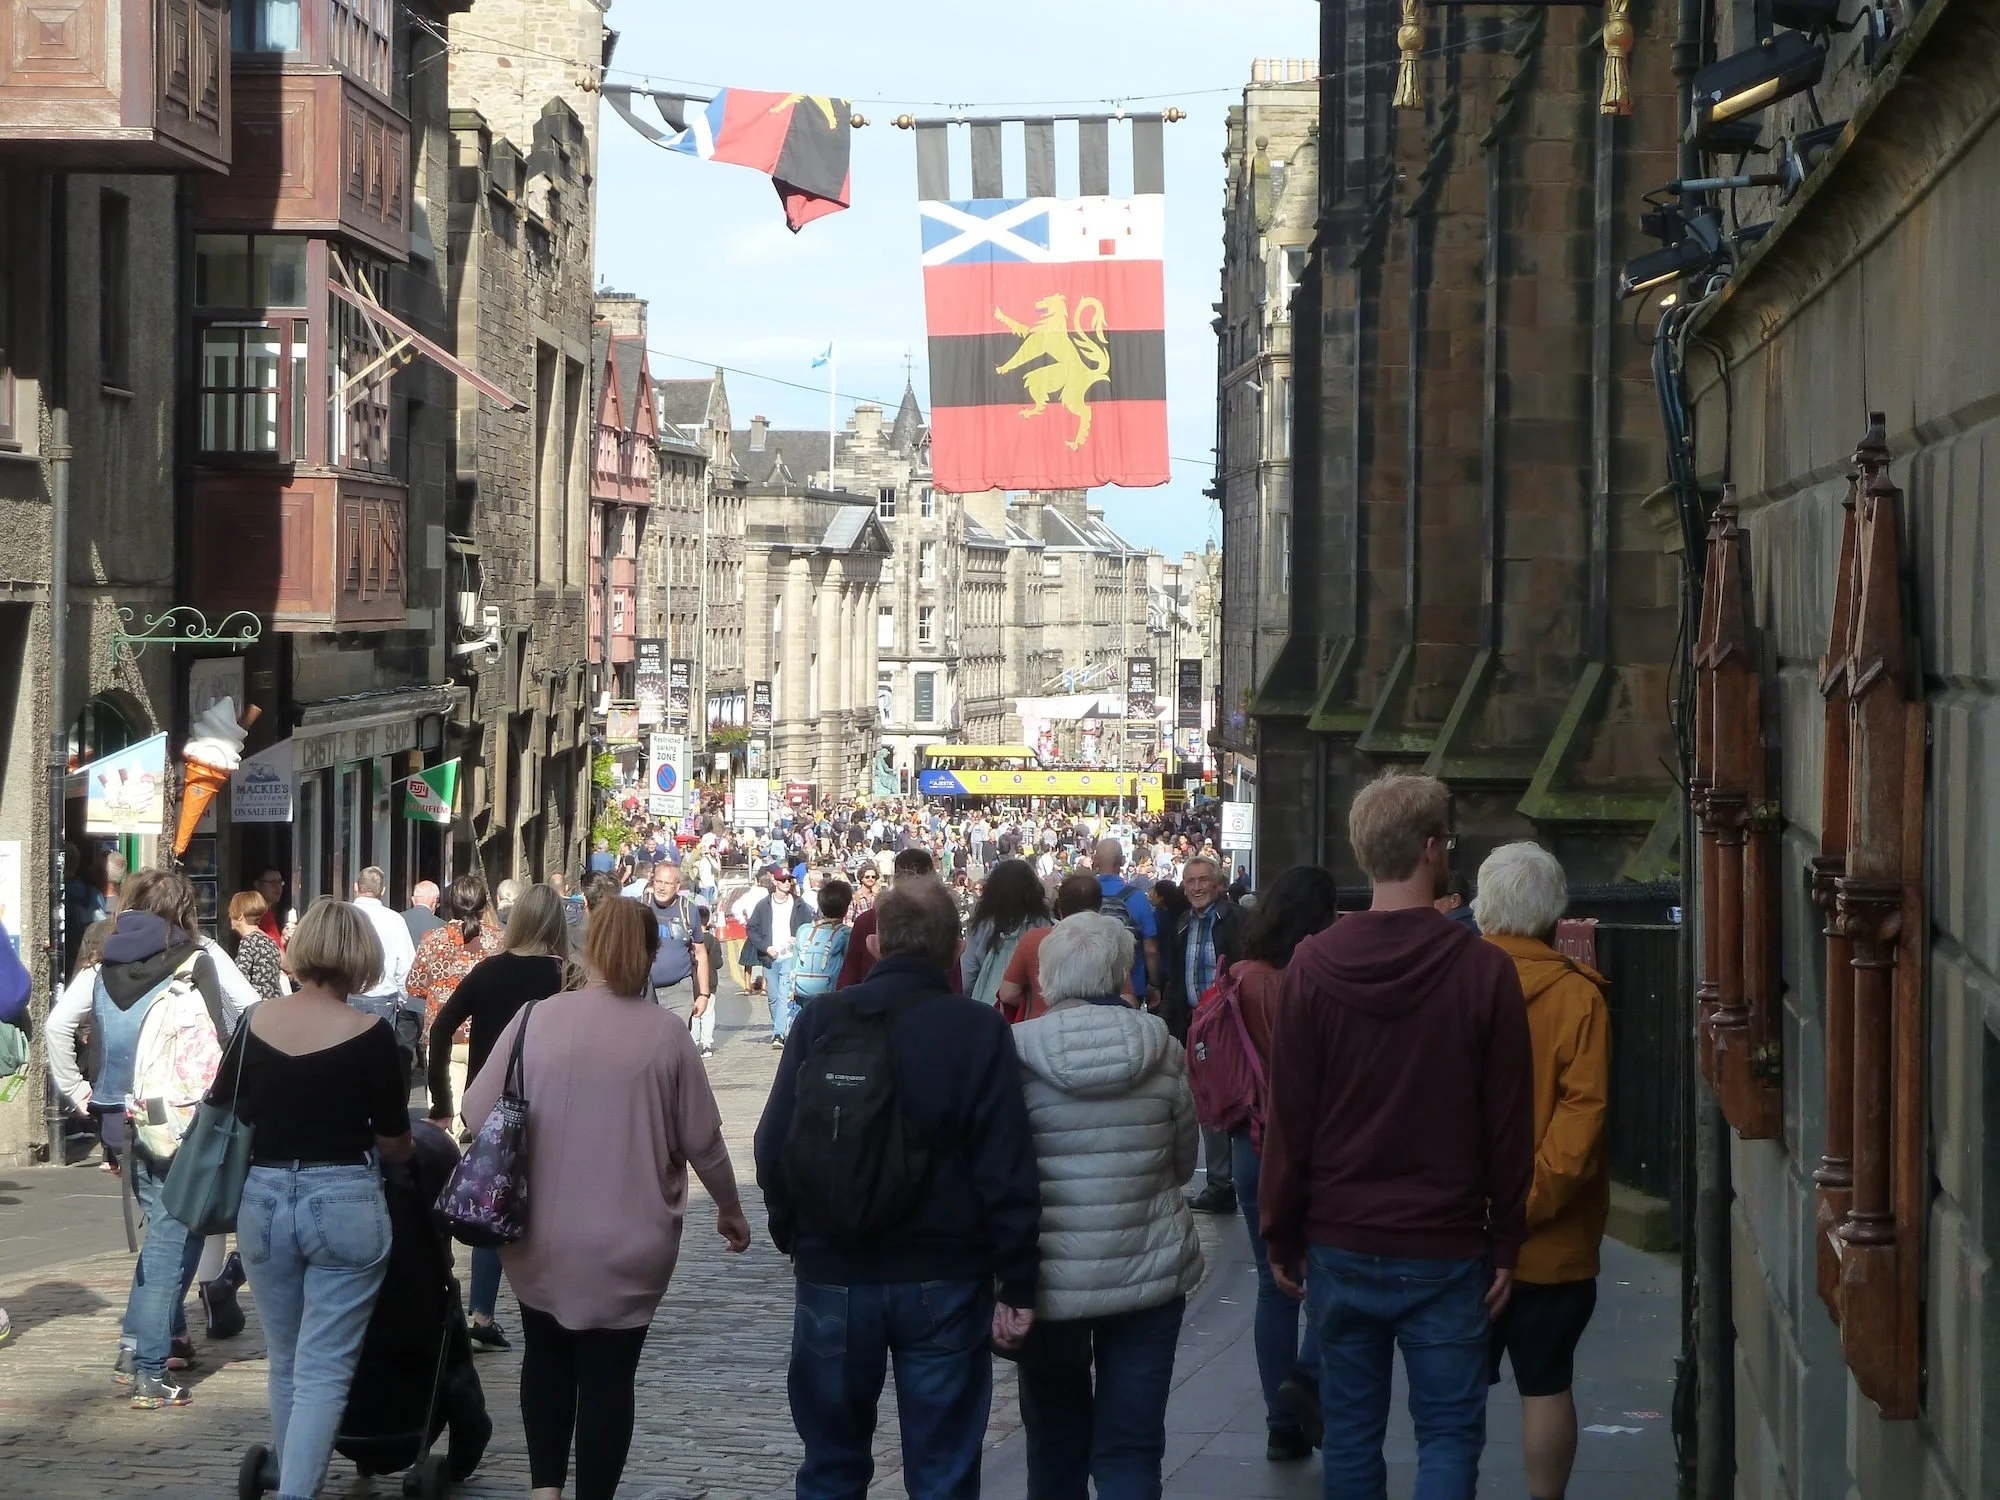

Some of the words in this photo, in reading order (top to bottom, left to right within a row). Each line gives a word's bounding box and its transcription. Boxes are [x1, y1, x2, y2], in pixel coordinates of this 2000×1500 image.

[654, 736, 680, 744] Restricted
[303, 733, 345, 767] CASTLE
[355, 727, 377, 757] GIFT
[385, 722, 409, 751] SHOP
[657, 744, 676, 752] parking
[657, 752, 676, 761] ZONE
[236, 784, 289, 794] MACKIE'S
[234, 808, 246, 816] ON
[248, 808, 266, 816] SALE
[268, 808, 290, 816] HERE
